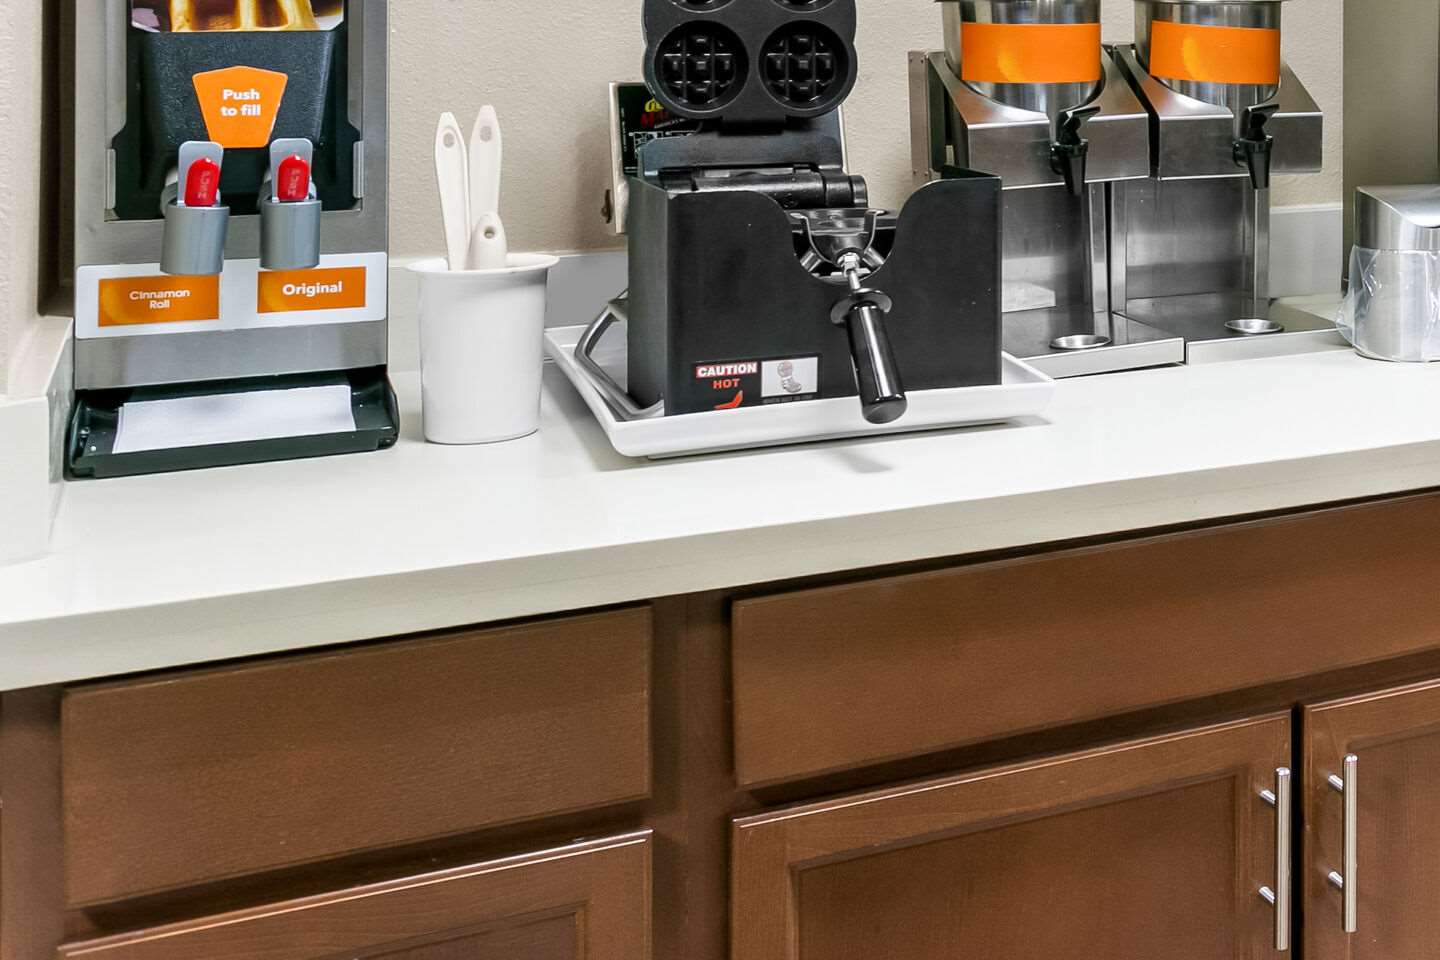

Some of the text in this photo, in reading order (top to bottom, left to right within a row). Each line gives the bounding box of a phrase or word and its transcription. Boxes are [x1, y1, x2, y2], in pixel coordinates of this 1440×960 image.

[223, 88, 260, 100] Push
[220, 103, 262, 117] to fill
[129, 289, 191, 300] Cinnamon
[282, 281, 343, 298] Original
[149, 299, 170, 309] Roll
[697, 363, 757, 377] CAUTION
[713, 378, 740, 389] HOT
